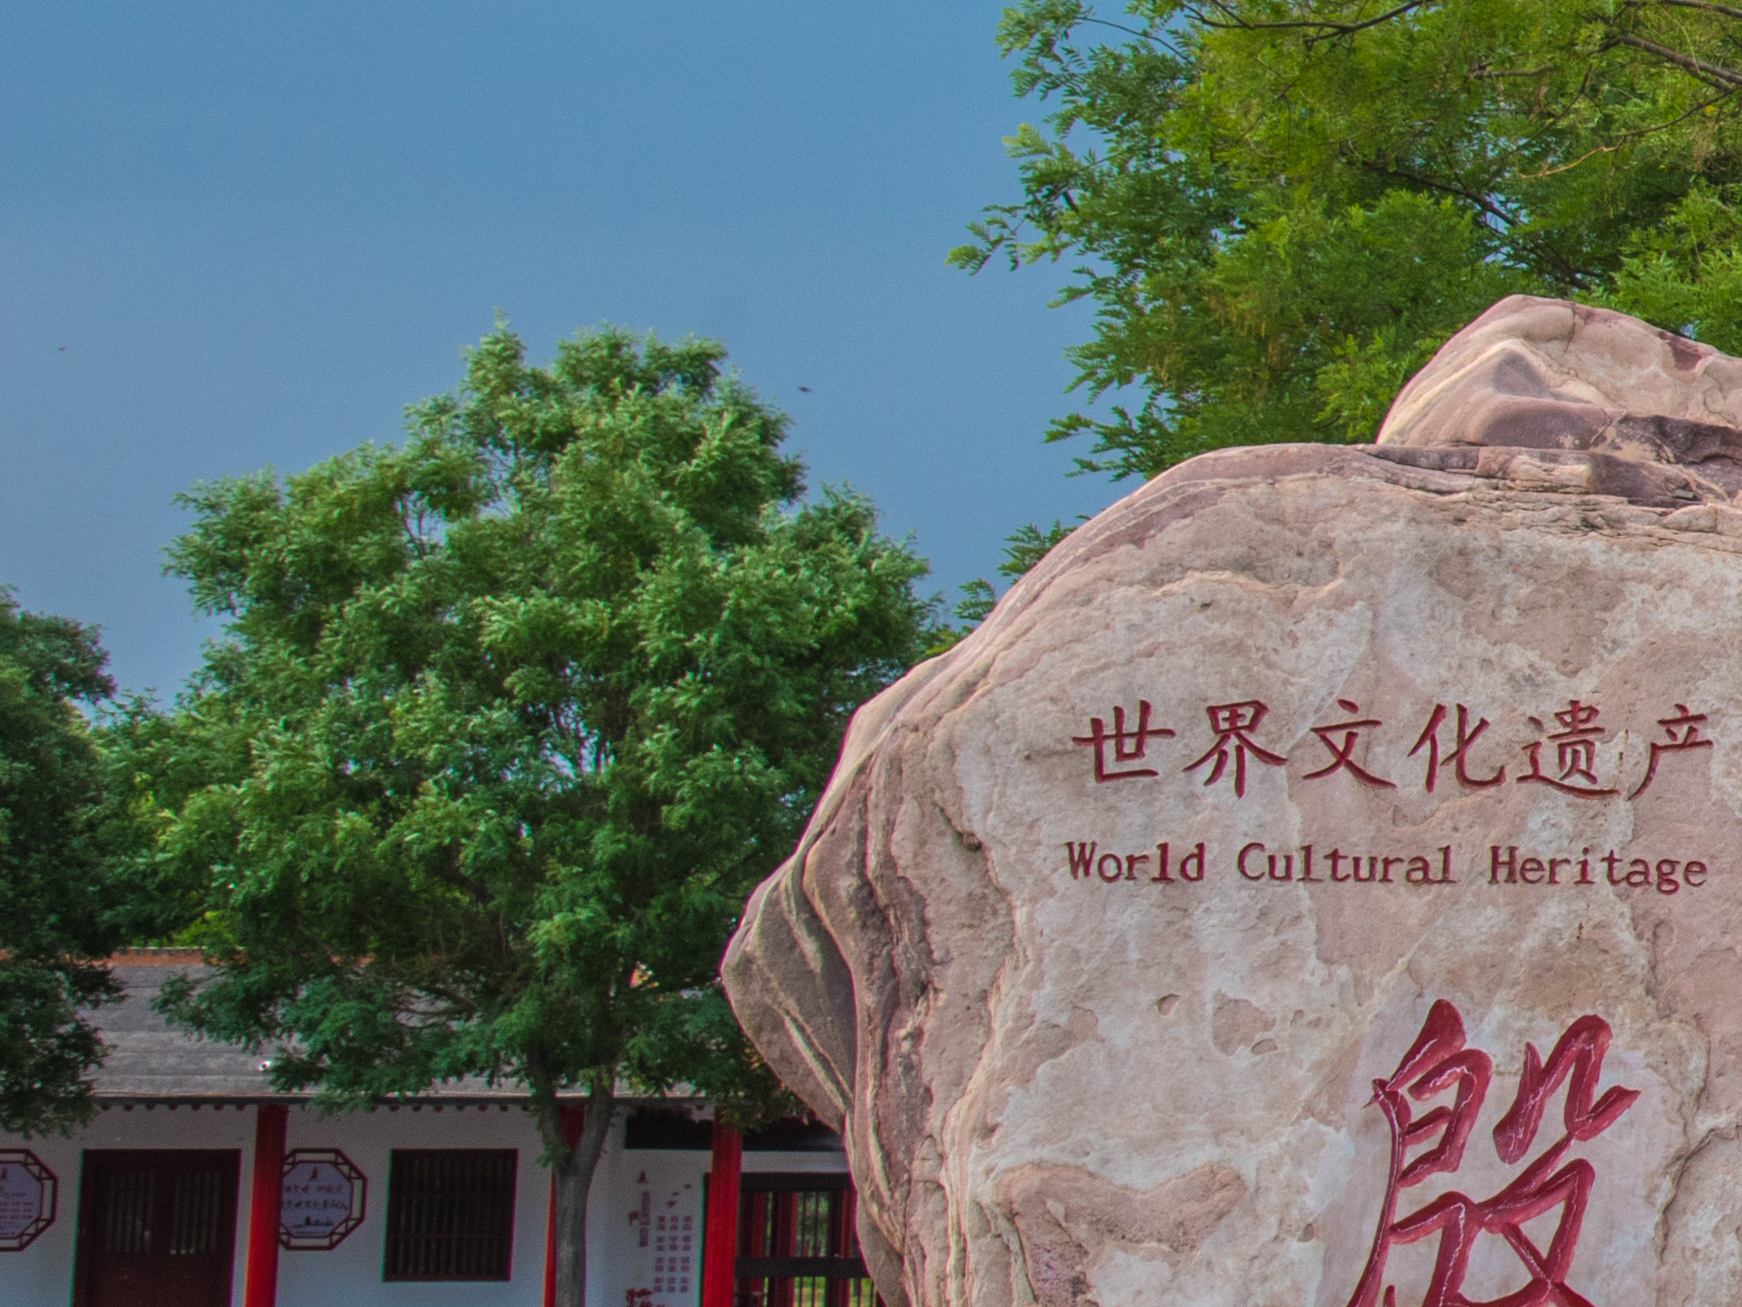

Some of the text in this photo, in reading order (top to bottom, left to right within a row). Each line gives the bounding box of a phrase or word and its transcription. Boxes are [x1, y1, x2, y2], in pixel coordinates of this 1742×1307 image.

[1071, 697, 1714, 801] 世界文化遗产
[1064, 841, 1709, 895] World Cultural Heritage
